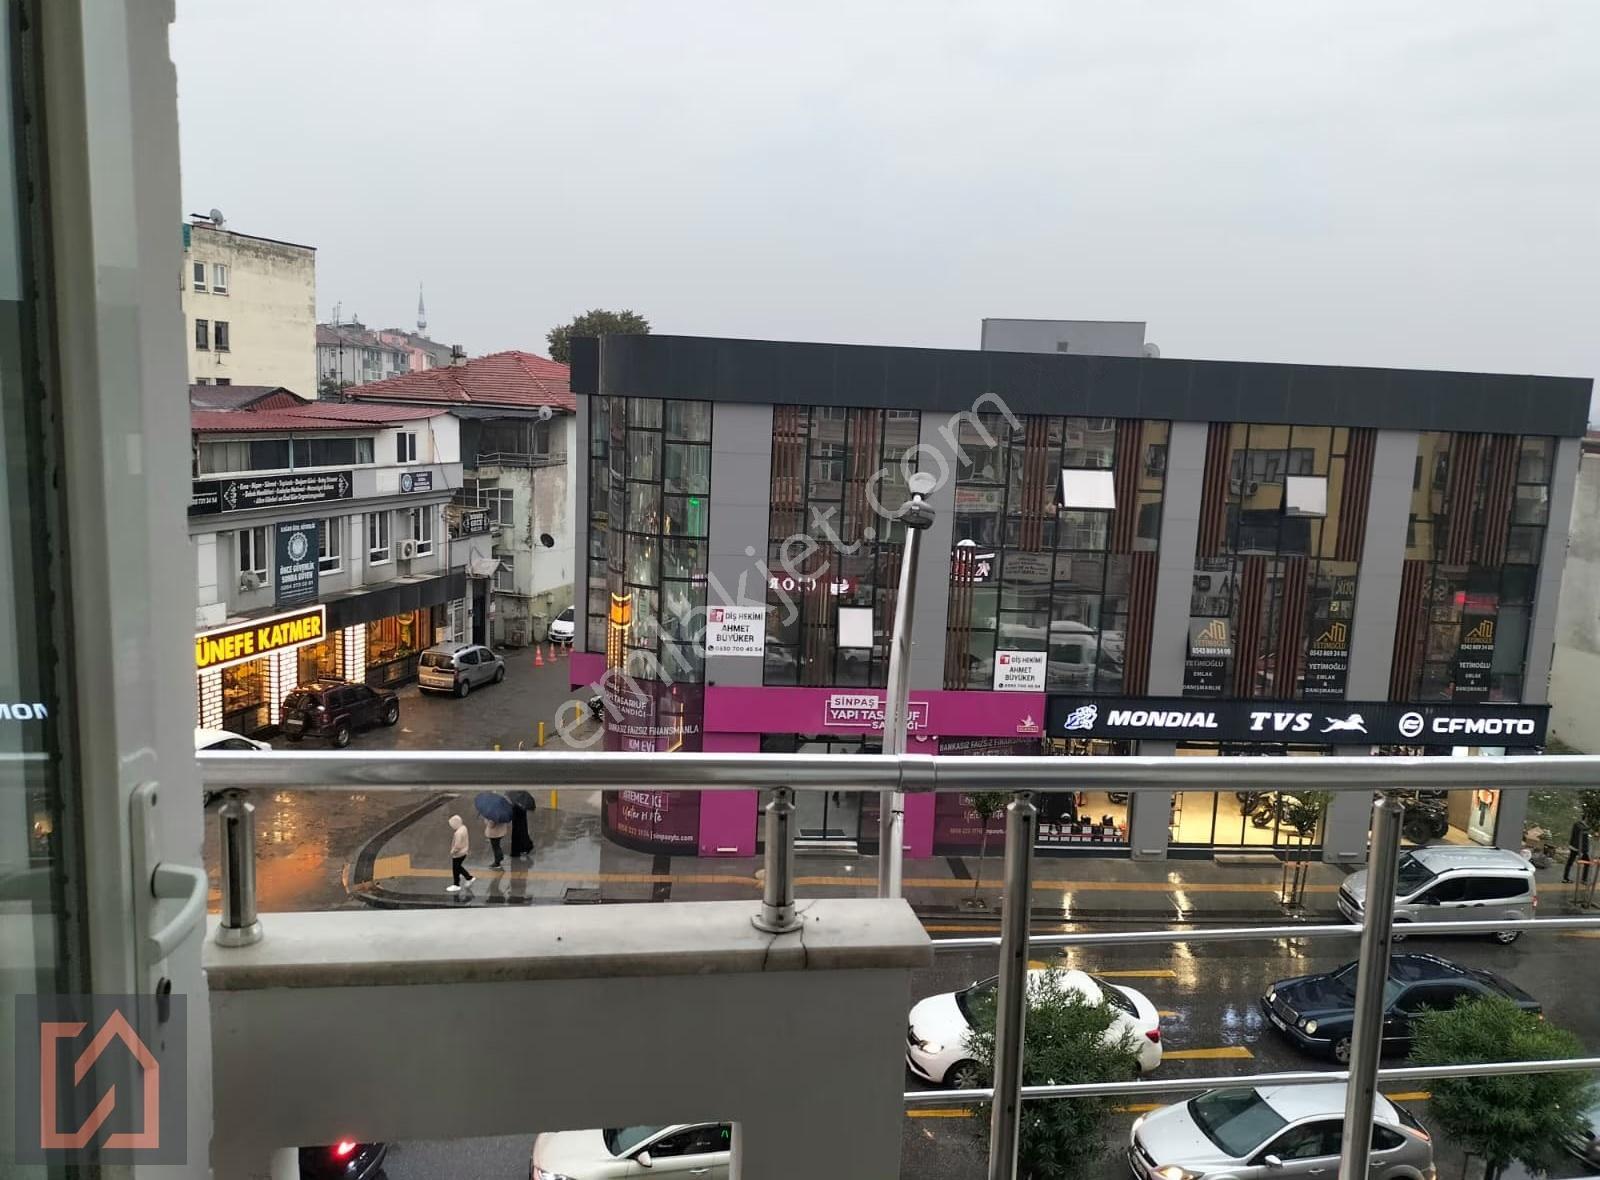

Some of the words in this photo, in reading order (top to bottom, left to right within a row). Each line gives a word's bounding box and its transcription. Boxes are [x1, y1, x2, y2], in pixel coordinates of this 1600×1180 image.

[726, 612, 737, 622] DİŞ
[738, 612, 763, 620] HEKİMİ
[258, 616, 320, 650] KATMER
[722, 624, 749, 632] AHMET
[834, 697, 875, 708] SİNPAŞ
[831, 709, 858, 720] YAPI
[1107, 710, 1218, 728] MONDIAL
[1250, 712, 1312, 731] TVS
[1432, 717, 1535, 735] CFMOTO
